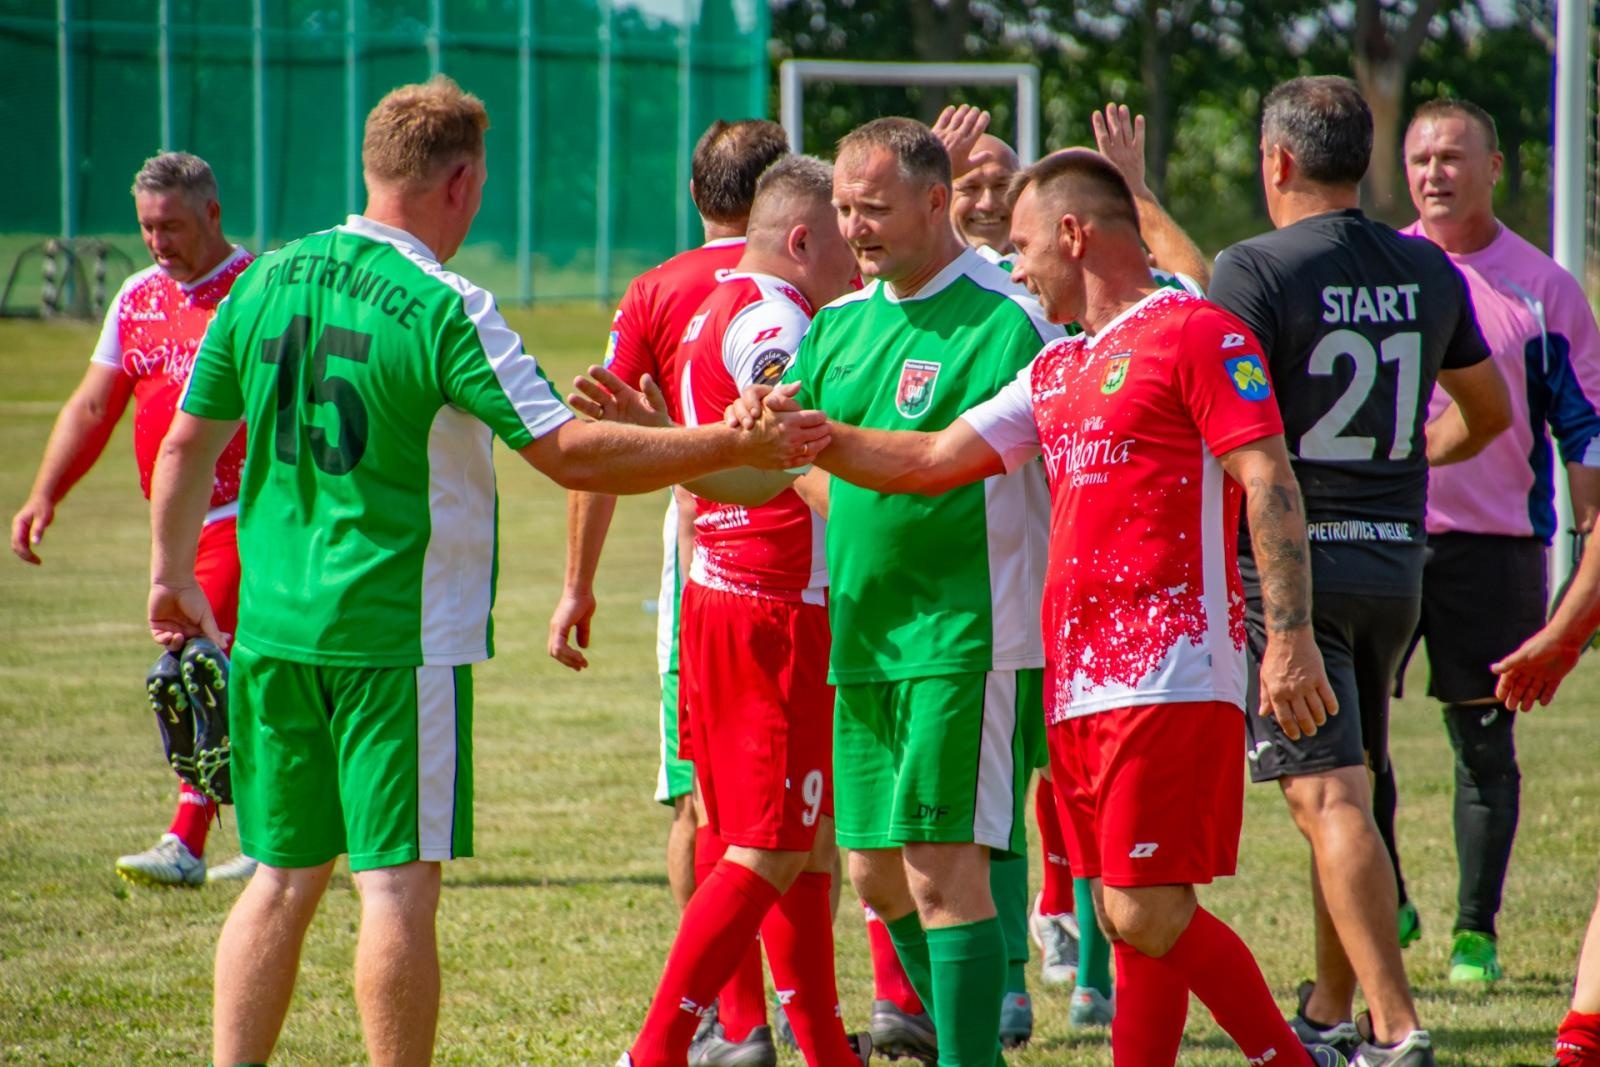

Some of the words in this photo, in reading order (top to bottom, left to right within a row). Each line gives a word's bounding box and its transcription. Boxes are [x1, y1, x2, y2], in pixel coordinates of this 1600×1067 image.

[264, 254, 428, 331] PIETROWICE
[1321, 283, 1420, 324] START
[261, 313, 374, 477] 15
[1299, 328, 1422, 461] 21
[1307, 520, 1377, 541] PIETROWICE
[802, 769, 823, 827] 9
